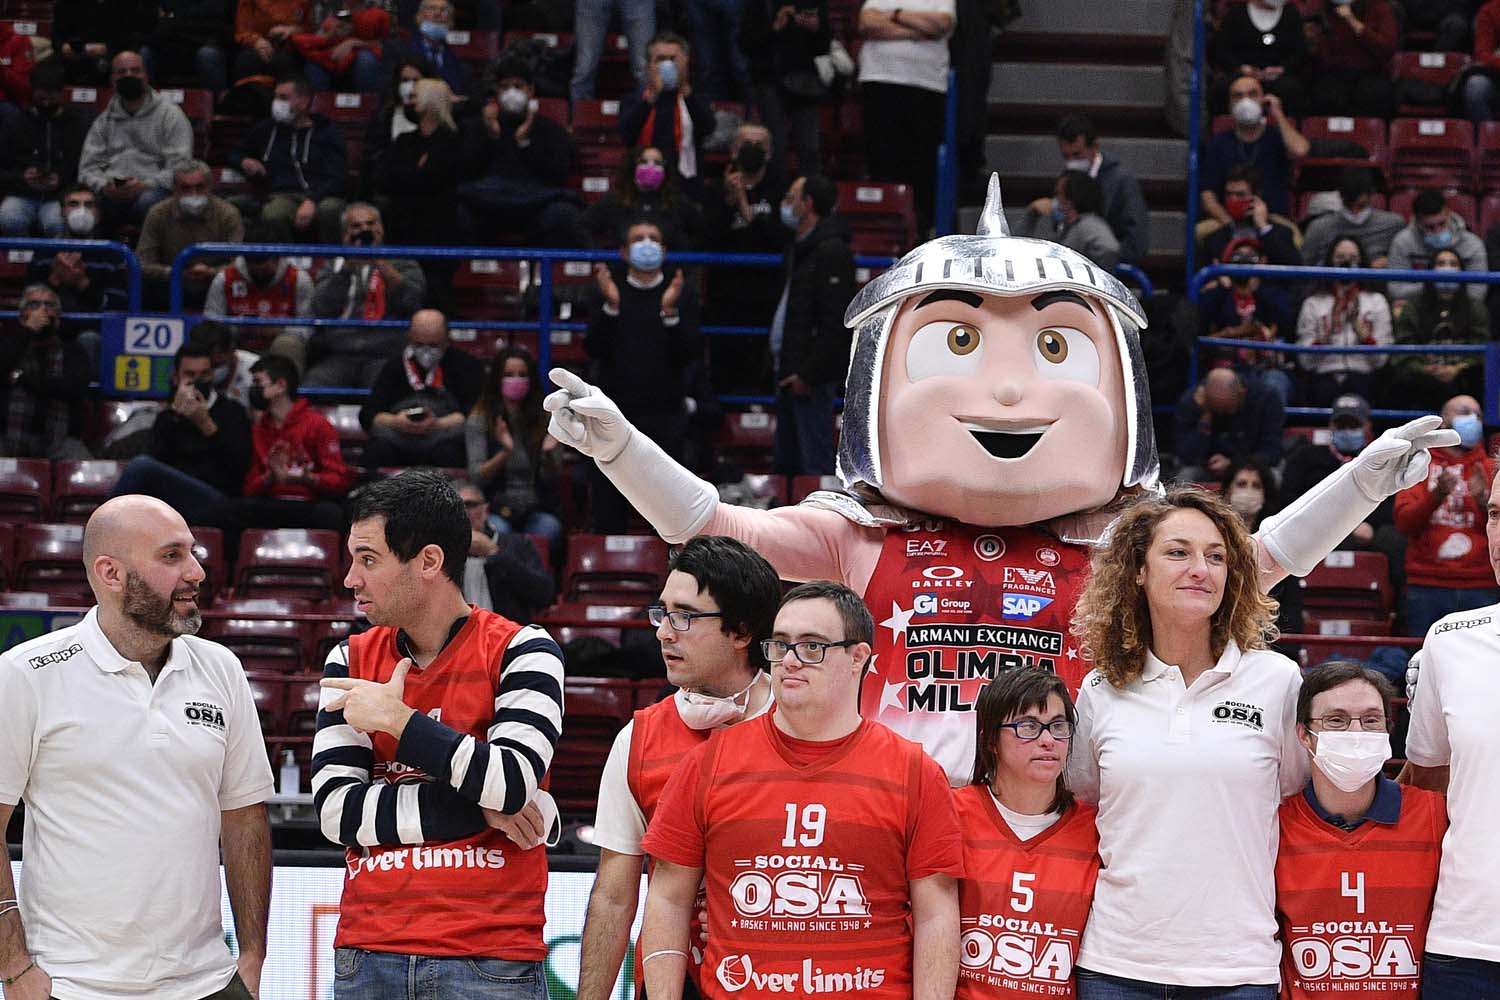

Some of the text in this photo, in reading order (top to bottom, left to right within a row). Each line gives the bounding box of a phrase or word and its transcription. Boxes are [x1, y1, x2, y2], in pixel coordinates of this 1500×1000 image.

[132, 323, 172, 349] 20
[906, 539, 948, 552] EA7
[912, 580, 973, 588] OAKLEY
[1002, 583, 1056, 595] FRAGRANCES
[940, 598, 971, 610] Group
[1002, 597, 1041, 617] SAP
[1434, 616, 1492, 635] Kappa
[908, 629, 1060, 651] ARMANI EXCHANGE
[28, 643, 84, 670] Kappa
[184, 706, 226, 728] OSA
[1213, 706, 1264, 729] OSA
[781, 803, 827, 848] 19
[412, 845, 505, 869] limits
[755, 855, 844, 871] SOCIAL
[729, 870, 872, 918] OSA
[1010, 871, 1036, 913] 5
[1341, 871, 1365, 914] 4
[740, 919, 860, 931] BASKET MILANO SINCE 1948
[978, 914, 1058, 936] SOCIAL
[1312, 921, 1393, 935] SOCIAL
[960, 927, 1074, 984] OSA
[1290, 935, 1420, 981] OSA
[716, 954, 885, 995] Over limits
[960, 970, 986, 984] ASKET
[987, 976, 1019, 991] MILANO
[1021, 983, 1045, 994] SINCE
[1332, 981, 1360, 992] MILANO
[1362, 981, 1387, 991] SINCE
